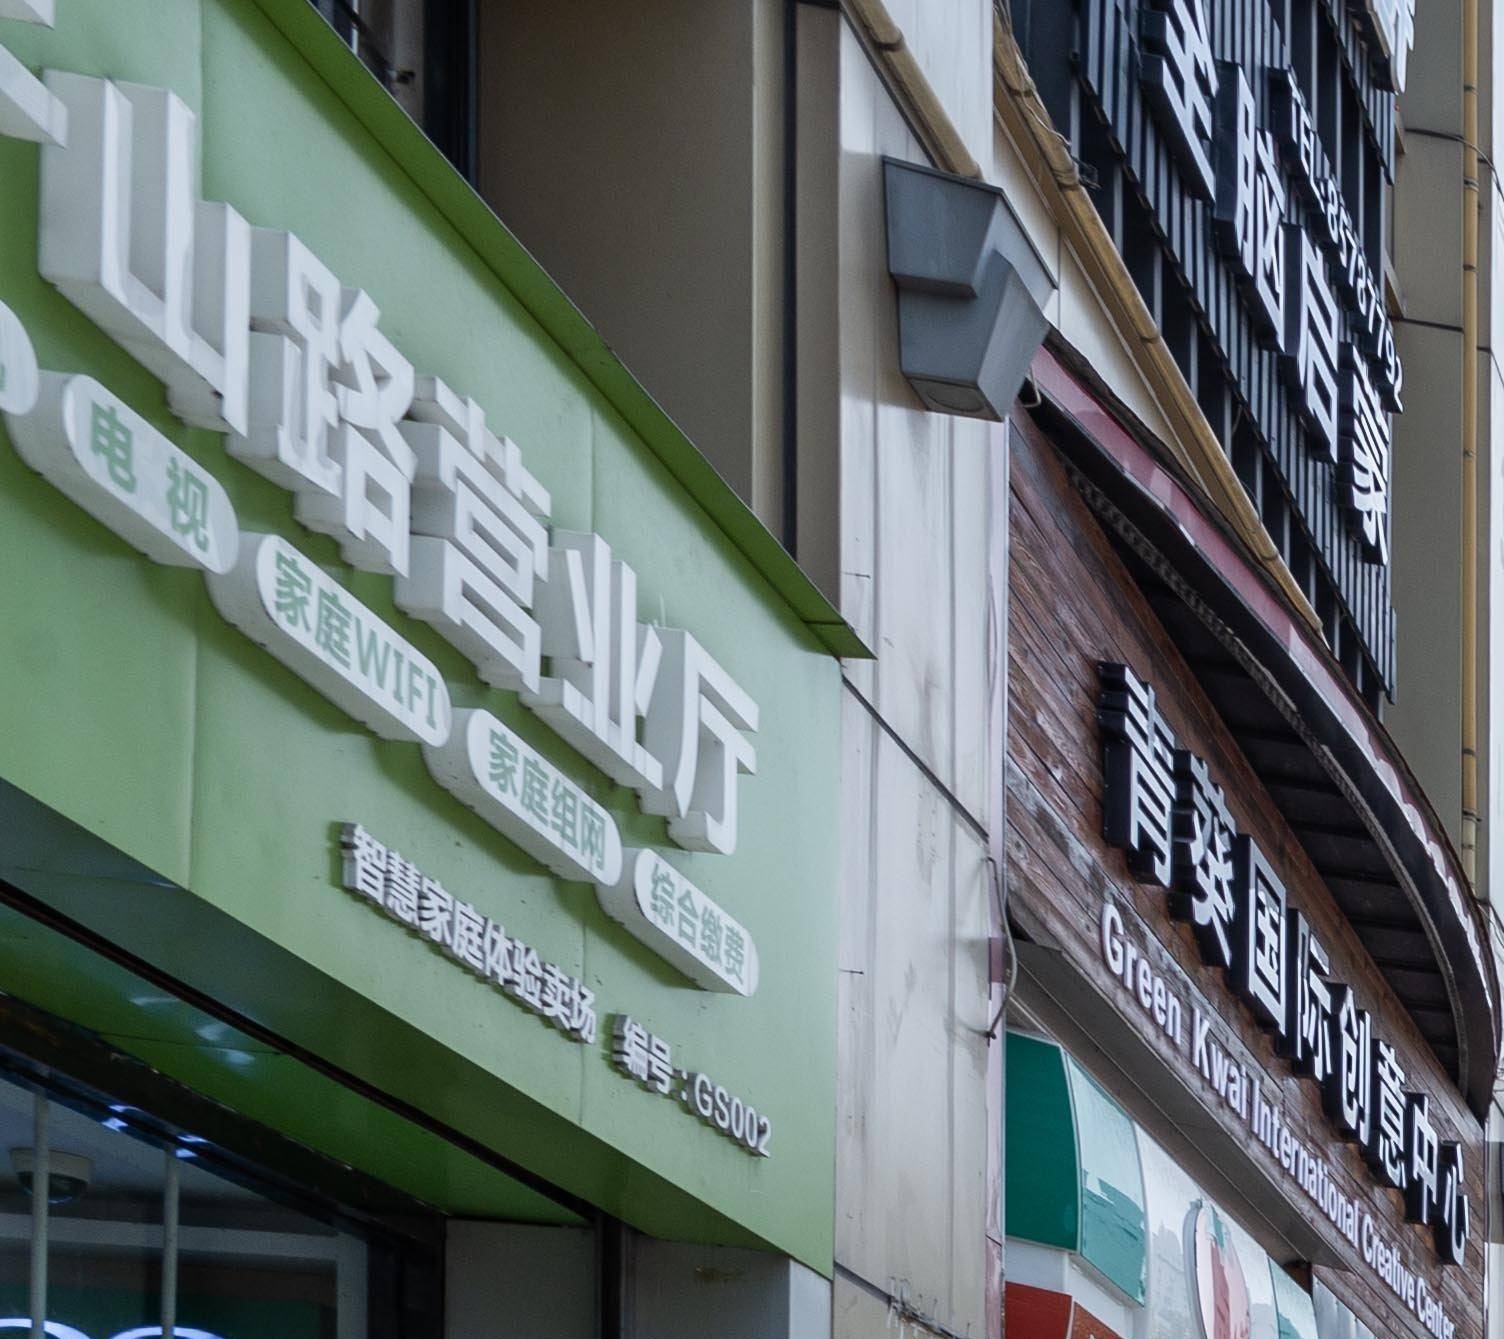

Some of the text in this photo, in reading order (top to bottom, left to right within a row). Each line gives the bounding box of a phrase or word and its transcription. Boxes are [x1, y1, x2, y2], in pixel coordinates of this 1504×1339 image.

[90, 401, 211, 555] 电视
[272, 551, 440, 731] 家庭WIFI
[488, 728, 607, 872] 家庭组网
[346, 824, 598, 1045] 智慧家庭体验卖场
[649, 861, 746, 988] 综合缴费
[1101, 902, 1182, 1045] Green
[1191, 1016, 1249, 1121] Kwai
[1251, 1070, 1360, 1246] International
[1361, 1207, 1416, 1314] Creative
